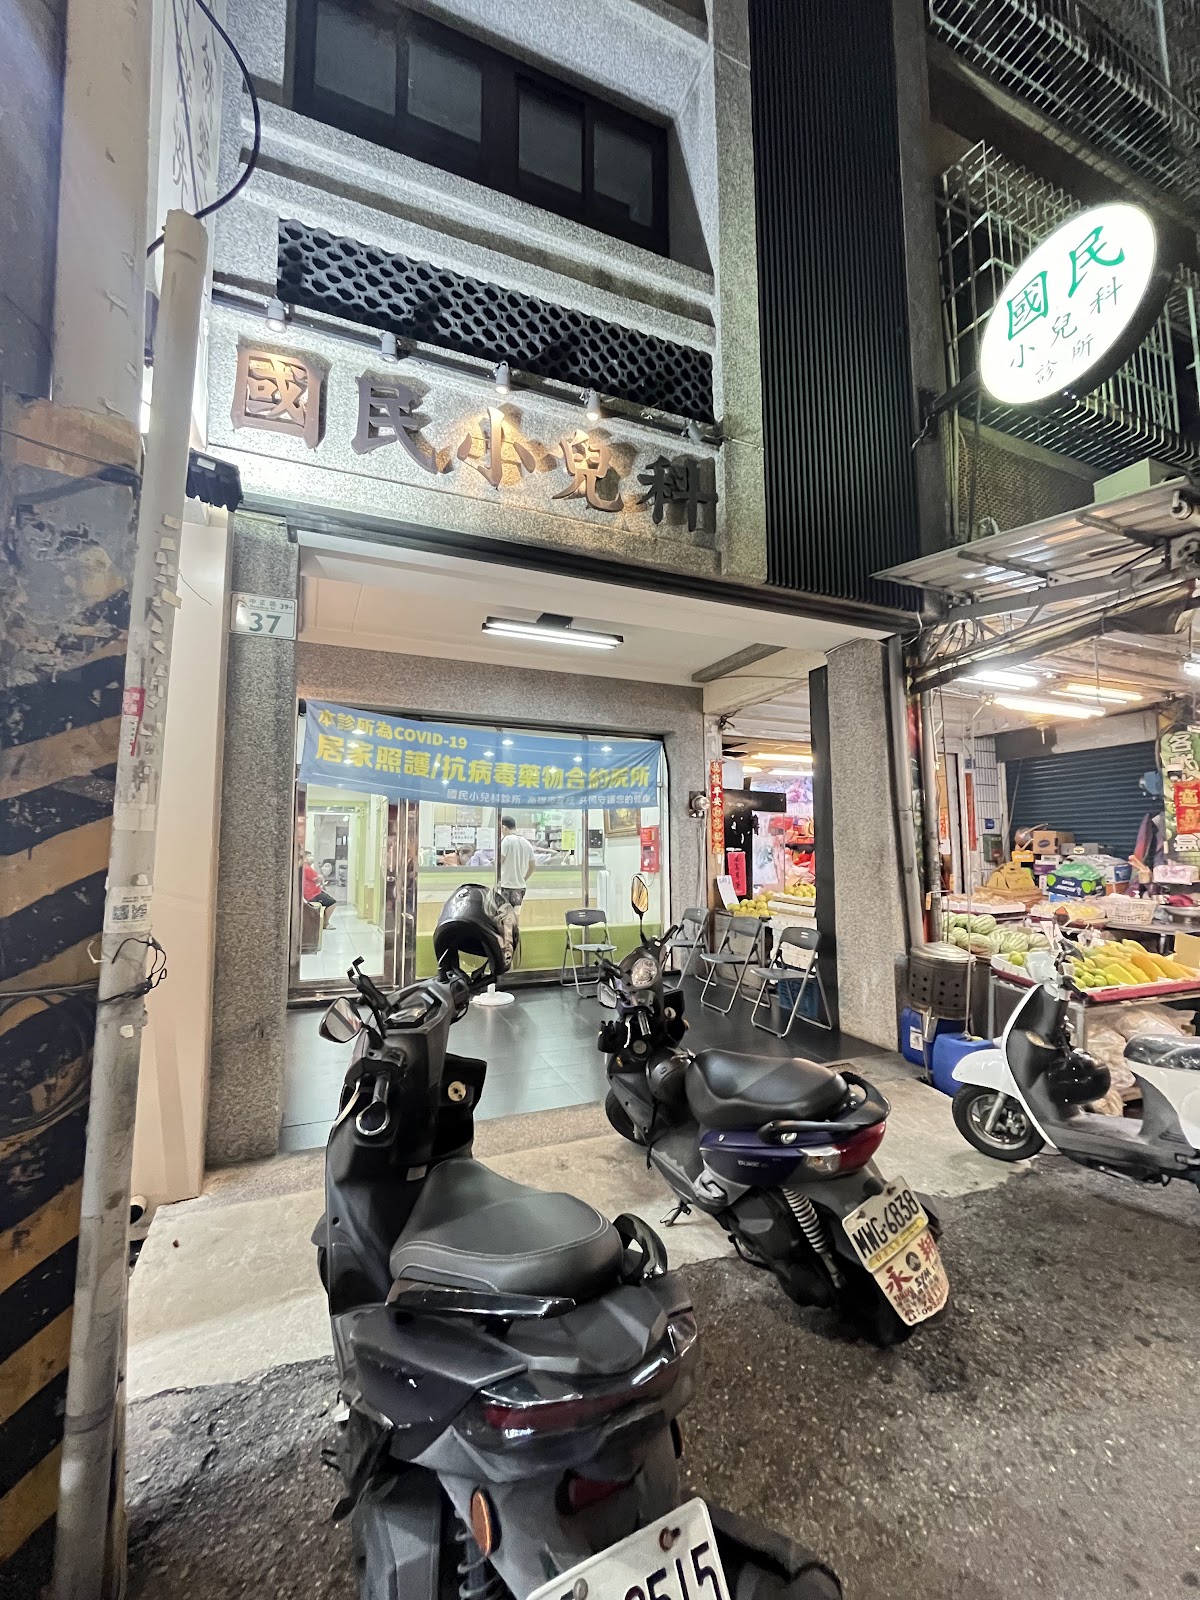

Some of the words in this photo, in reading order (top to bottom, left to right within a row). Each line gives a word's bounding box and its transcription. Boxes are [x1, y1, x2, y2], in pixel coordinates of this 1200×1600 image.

[1007, 226, 1125, 340] 國民
[1010, 277, 1123, 368] 小兒科
[1035, 334, 1094, 384] 診所
[231, 343, 717, 532] 國民小兒科
[249, 612, 281, 633] 37
[885, 1265, 914, 1295] 永
